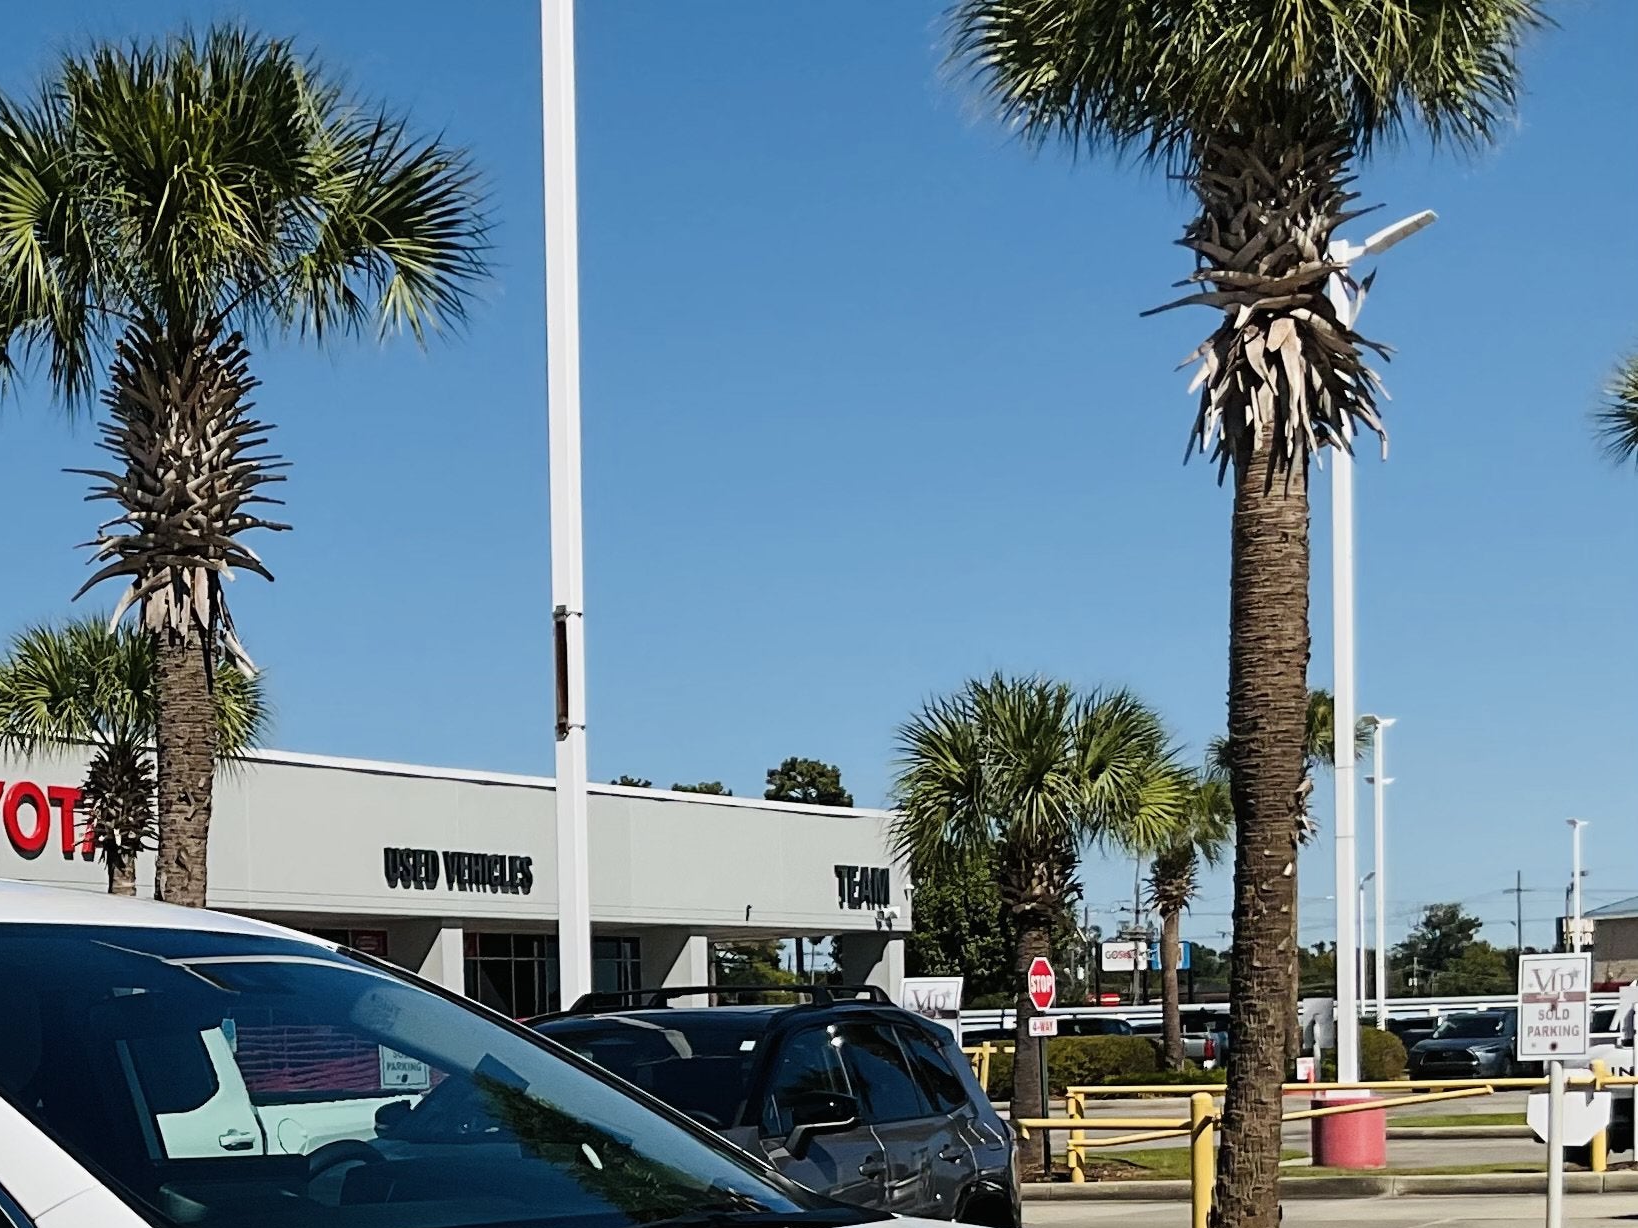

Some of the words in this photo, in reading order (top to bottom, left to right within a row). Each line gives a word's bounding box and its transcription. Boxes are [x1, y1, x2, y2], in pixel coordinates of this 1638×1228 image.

[383, 847, 440, 890] USED
[442, 851, 534, 895] VEHICLES
[834, 865, 890, 910] TEAM
[1030, 974, 1053, 994] STOP
[1537, 1007, 1570, 1021] SOLD
[1032, 1020, 1054, 1032] 4-WAY
[1527, 1024, 1580, 1038] PARKING
